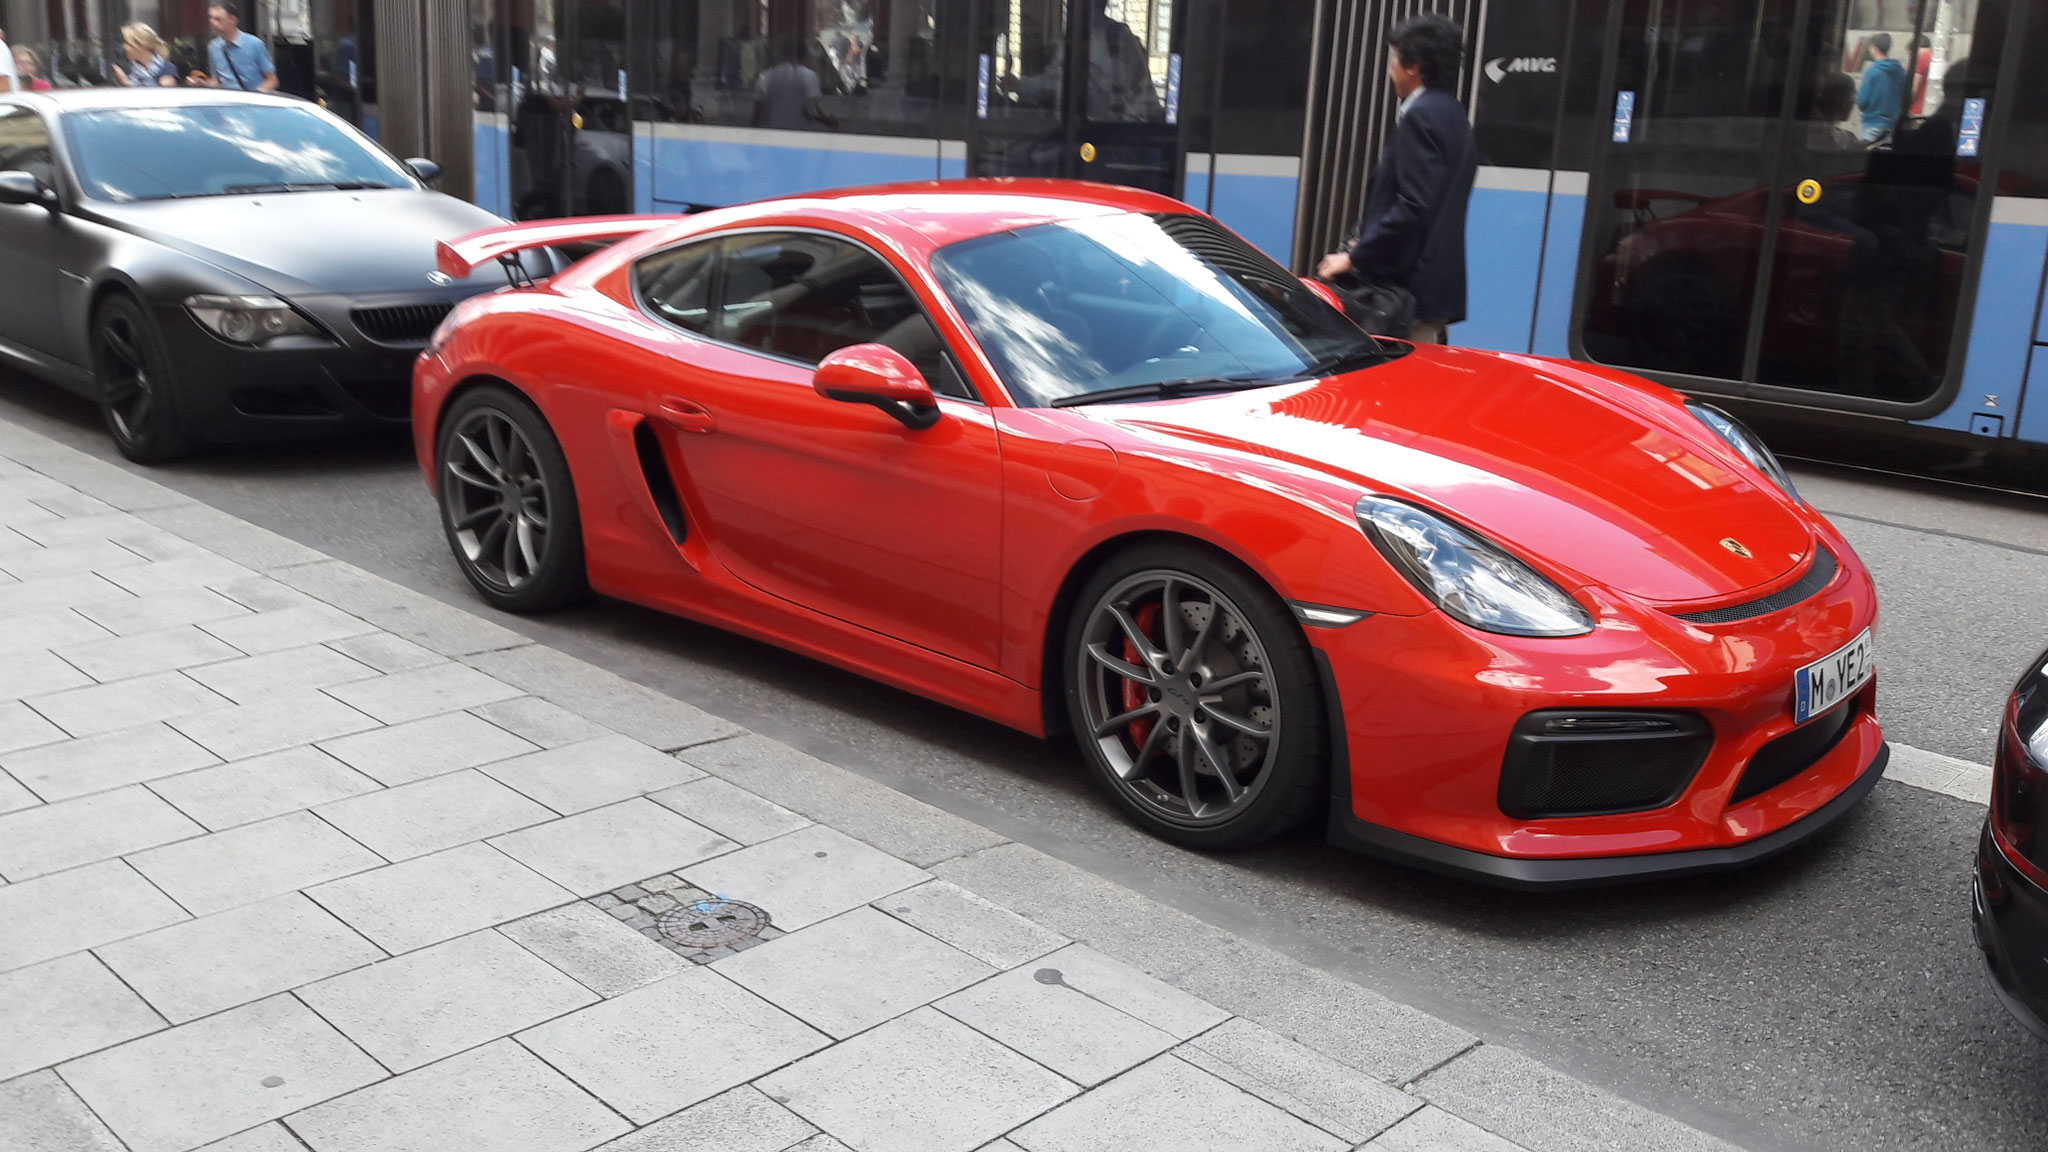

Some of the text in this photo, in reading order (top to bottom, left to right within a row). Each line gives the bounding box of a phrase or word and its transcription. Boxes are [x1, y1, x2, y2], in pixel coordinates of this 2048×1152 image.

[1506, 57, 1557, 72] MVG
[1811, 667, 1824, 710] M
[1800, 701, 1806, 712] D
